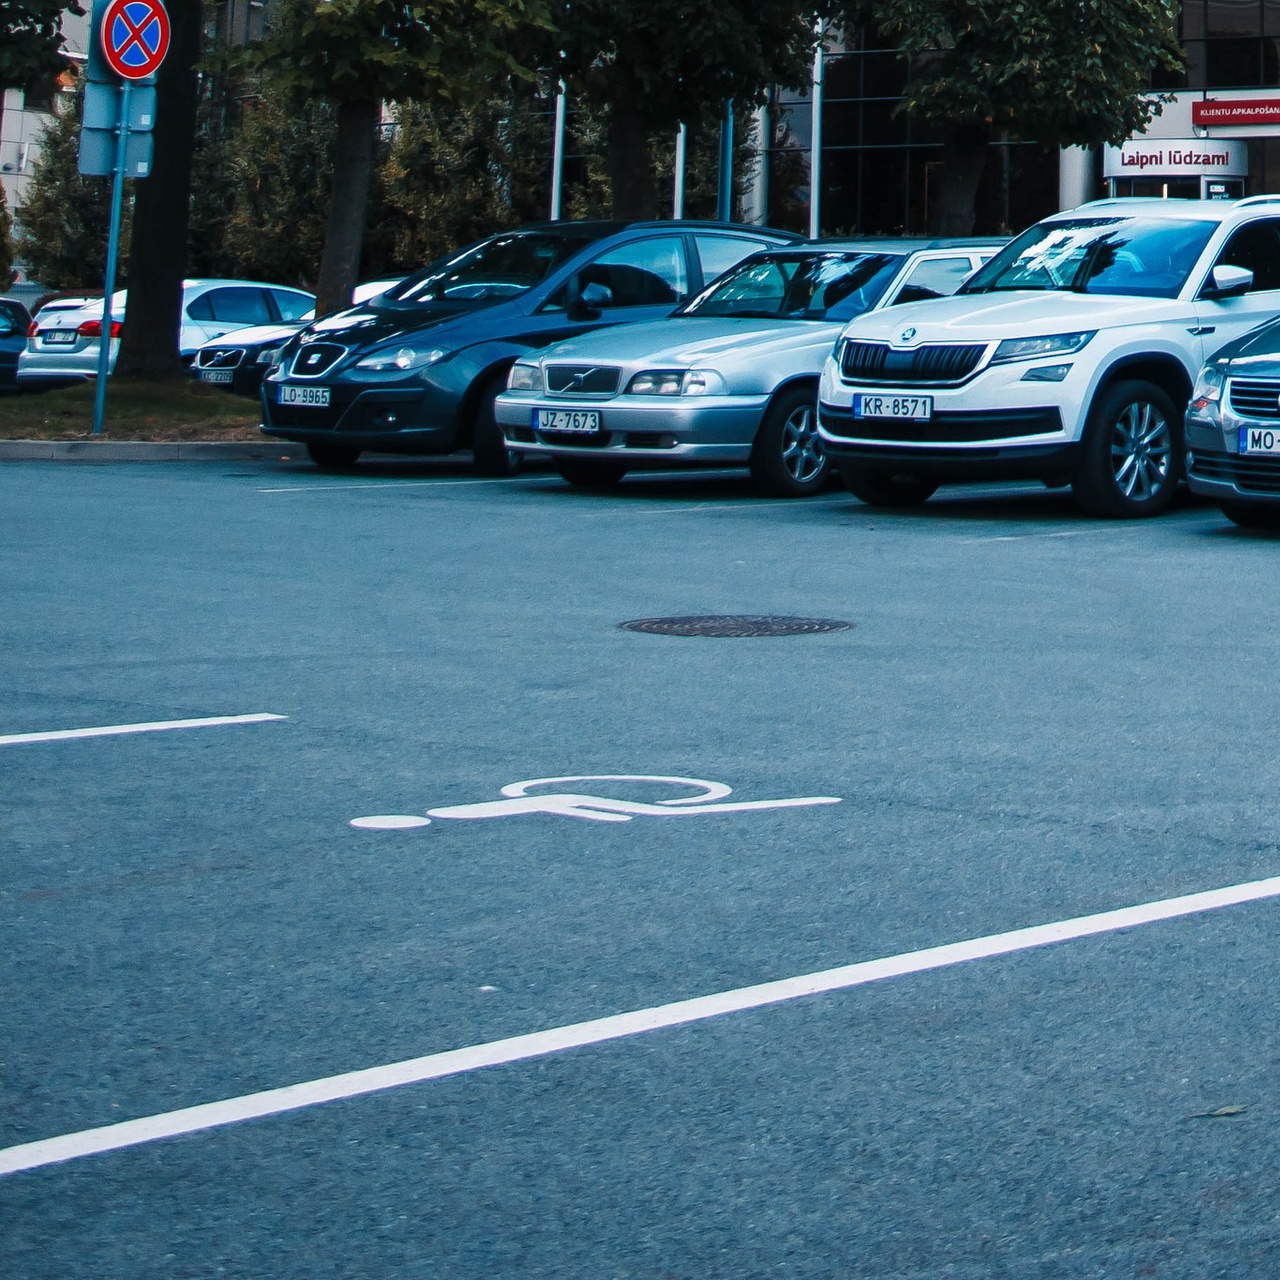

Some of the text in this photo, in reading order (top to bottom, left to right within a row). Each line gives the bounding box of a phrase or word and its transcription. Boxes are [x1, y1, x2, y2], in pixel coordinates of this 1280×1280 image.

[1200, 108, 1231, 116] KLIENTU
[1121, 150, 1230, 169] Laipni lūdzam!
[283, 387, 329, 405] LO-9965
[864, 397, 928, 417] KR-8571
[542, 411, 597, 429] JZ-7673
